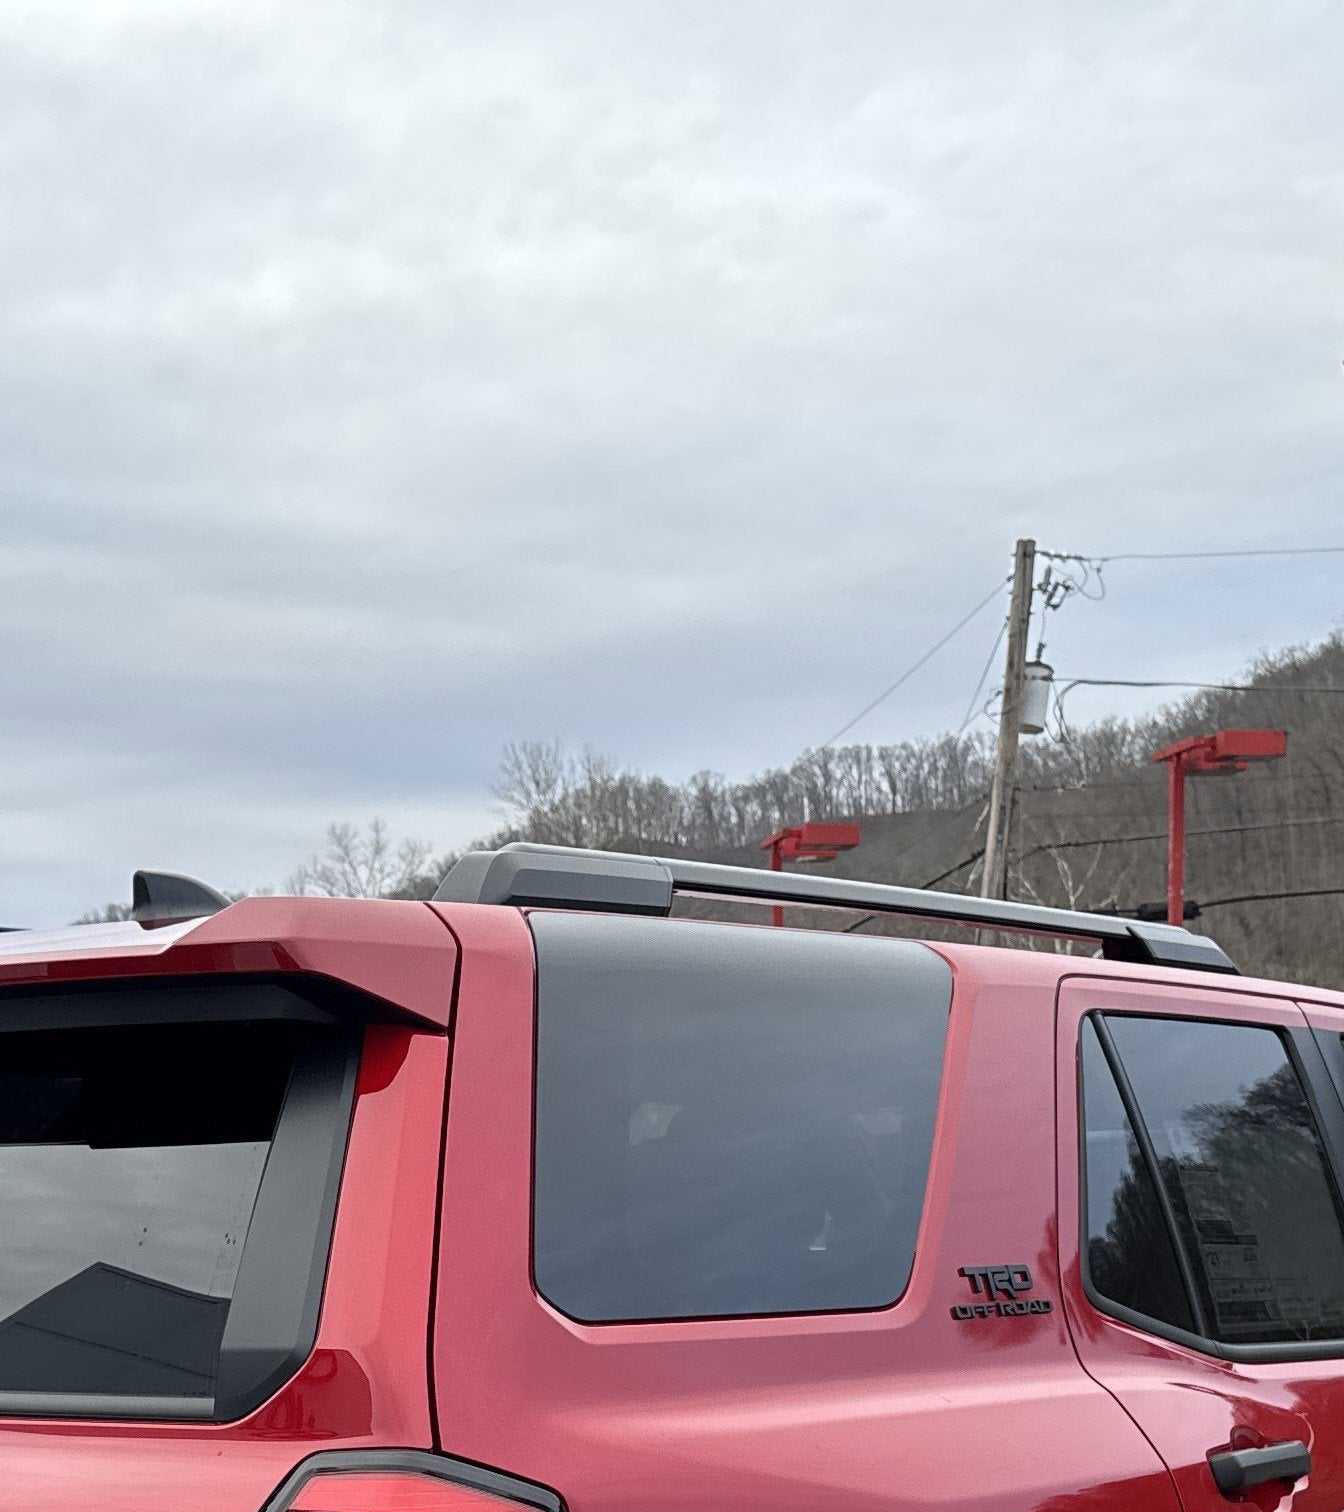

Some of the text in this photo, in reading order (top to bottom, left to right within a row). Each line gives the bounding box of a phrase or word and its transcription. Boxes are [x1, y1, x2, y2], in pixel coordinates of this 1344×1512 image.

[957, 1265, 1033, 1301] TRD
[950, 1300, 1053, 1320] OFF ROAD
